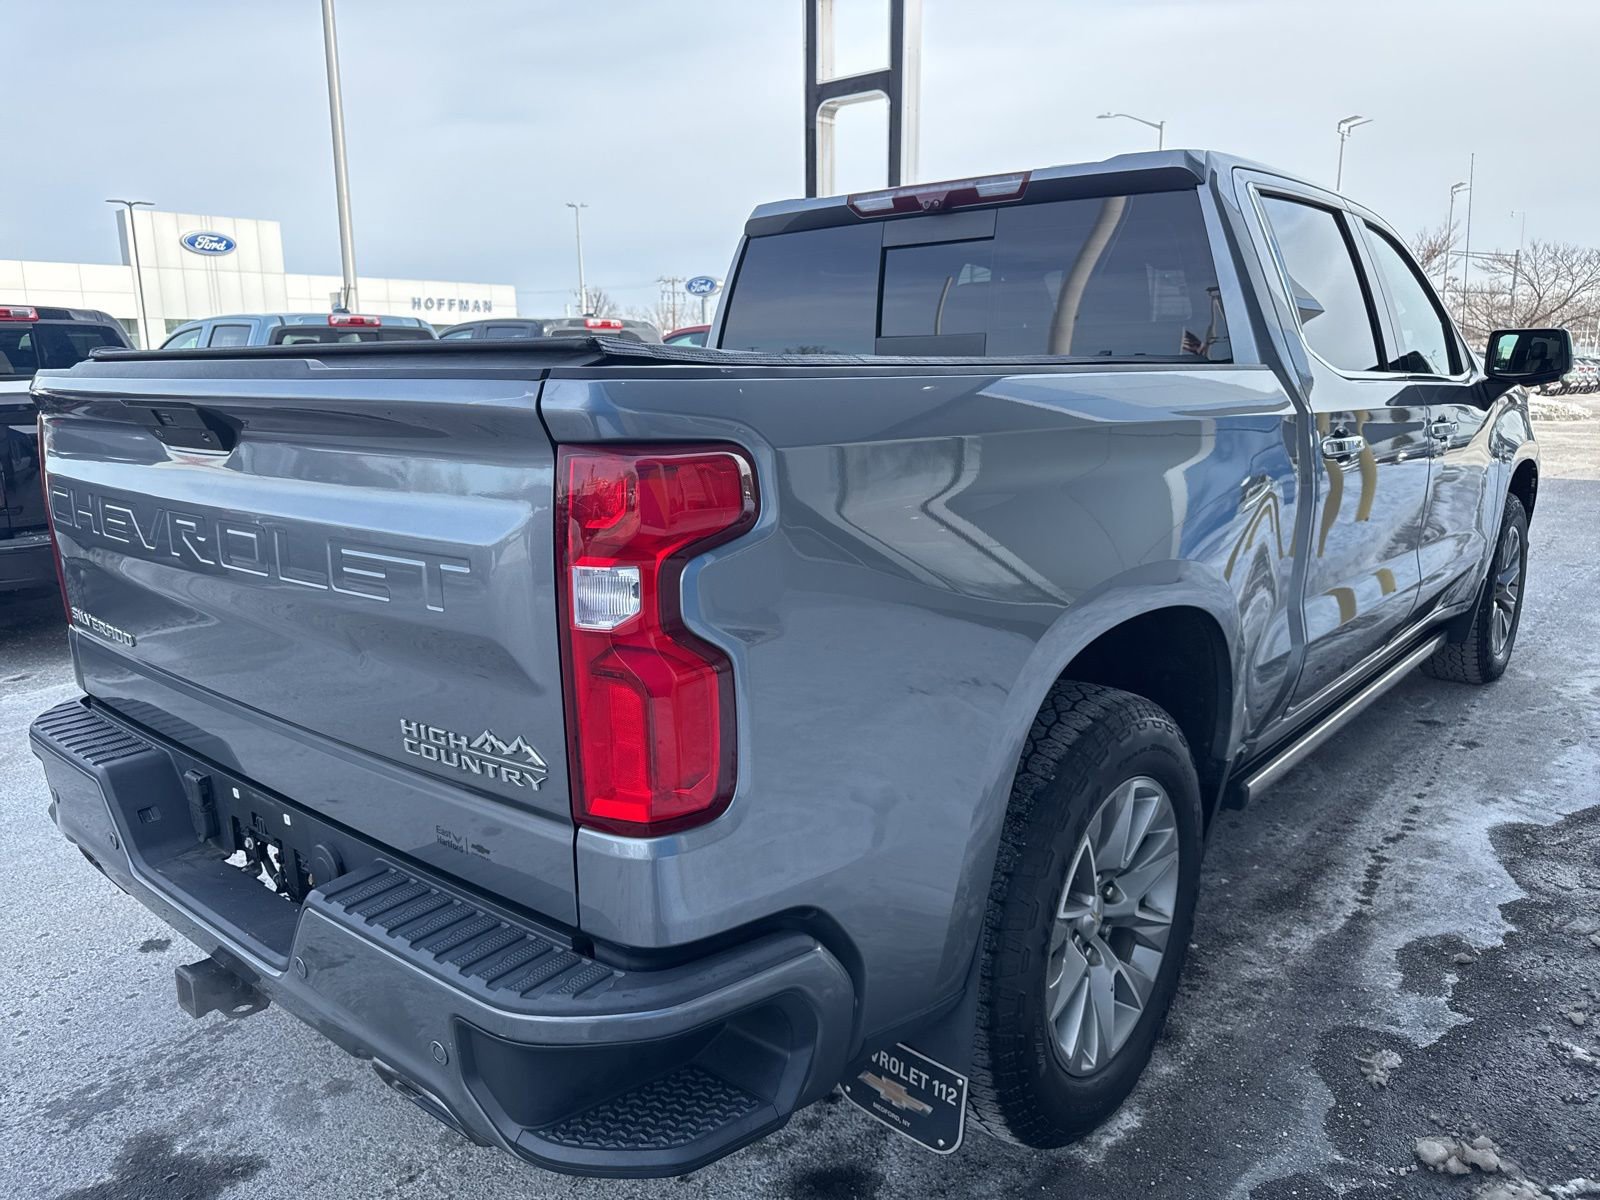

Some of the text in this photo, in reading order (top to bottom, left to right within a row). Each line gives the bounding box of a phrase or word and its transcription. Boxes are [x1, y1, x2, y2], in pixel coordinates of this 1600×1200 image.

[194, 235, 227, 251] Ford
[411, 297, 493, 313] HOFFMAN
[49, 482, 471, 613] CHEVROLET
[71, 607, 135, 647] SILVERADO
[400, 718, 470, 752] HIGH
[404, 738, 548, 791] COUNTRY
[436, 825, 452, 838] East
[436, 835, 464, 853] Hartford
[932, 1079, 958, 1106] 112
